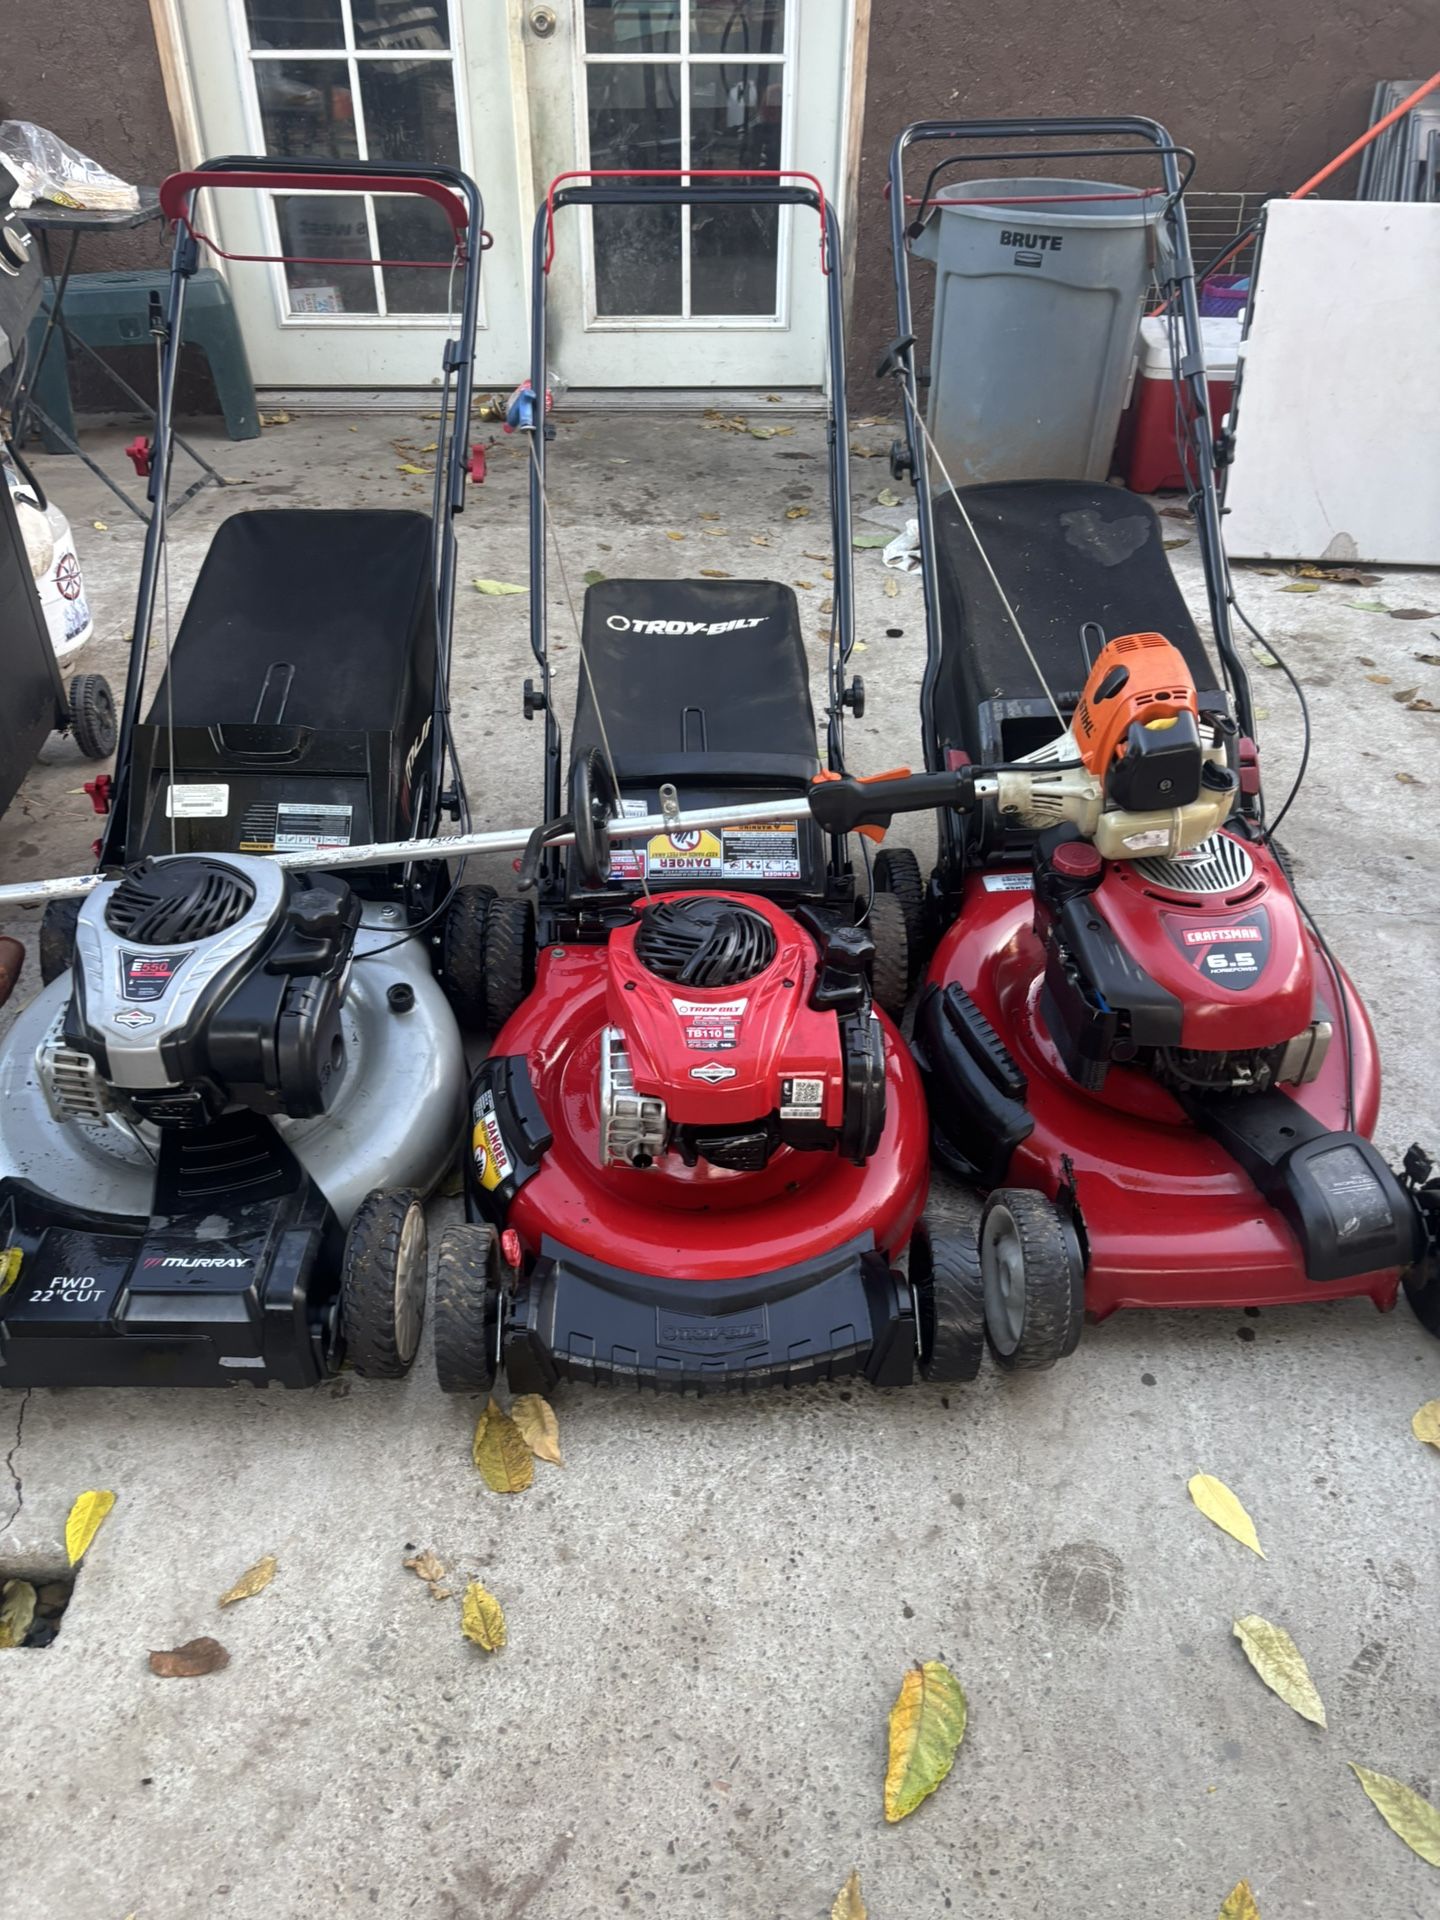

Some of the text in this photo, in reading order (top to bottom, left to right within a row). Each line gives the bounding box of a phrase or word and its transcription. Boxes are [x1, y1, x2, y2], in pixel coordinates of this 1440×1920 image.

[1000, 230, 1063, 251] BRUTE
[632, 617, 764, 635] TROY-BILT
[660, 858, 711, 868] DANGER
[1187, 928, 1259, 942] CRAFTSMAN
[1206, 952, 1256, 968] 6.5
[131, 962, 168, 972] E550
[1210, 966, 1258, 974] HORSEPOWER
[686, 1029, 722, 1038] TB110
[487, 1120, 507, 1168] DANGER
[161, 1257, 250, 1268] MURRAY
[49, 1277, 96, 1289] FWD
[29, 1289, 106, 1302] 22"CUT
